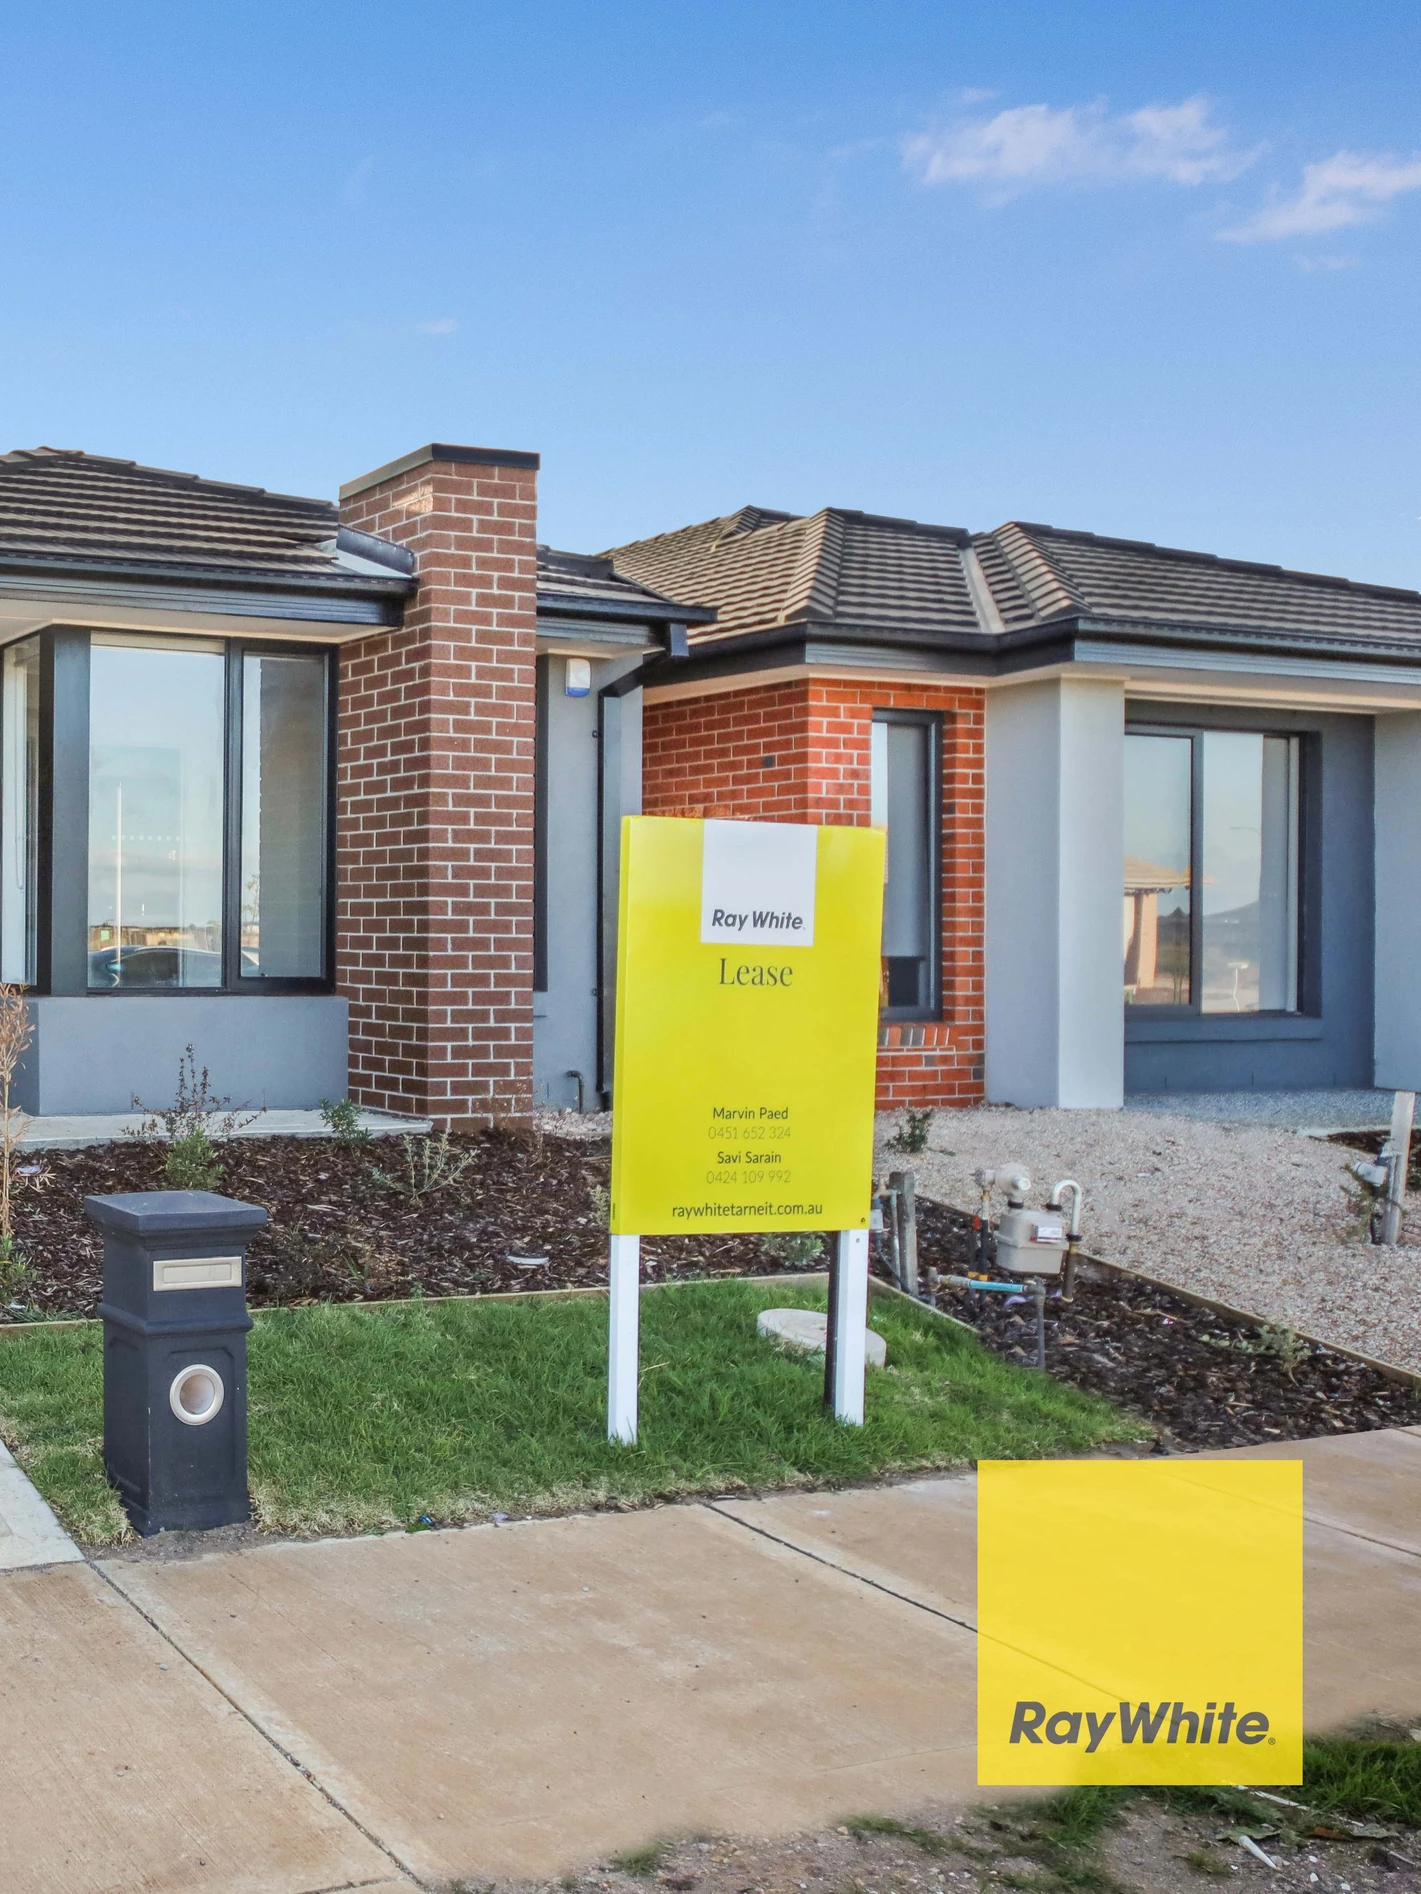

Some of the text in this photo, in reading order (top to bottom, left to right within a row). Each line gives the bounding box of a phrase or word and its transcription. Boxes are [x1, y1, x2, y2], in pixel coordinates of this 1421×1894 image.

[711, 908, 804, 932] Ray White
[719, 957, 793, 987] Lease
[712, 1106, 789, 1120] Marvin Paed
[708, 1126, 791, 1140] 0451 652 324
[717, 1150, 782, 1164] Savi Sarain
[706, 1169, 791, 1184] 0424 109 992
[672, 1201, 823, 1220] raywhitetarneit.com.au
